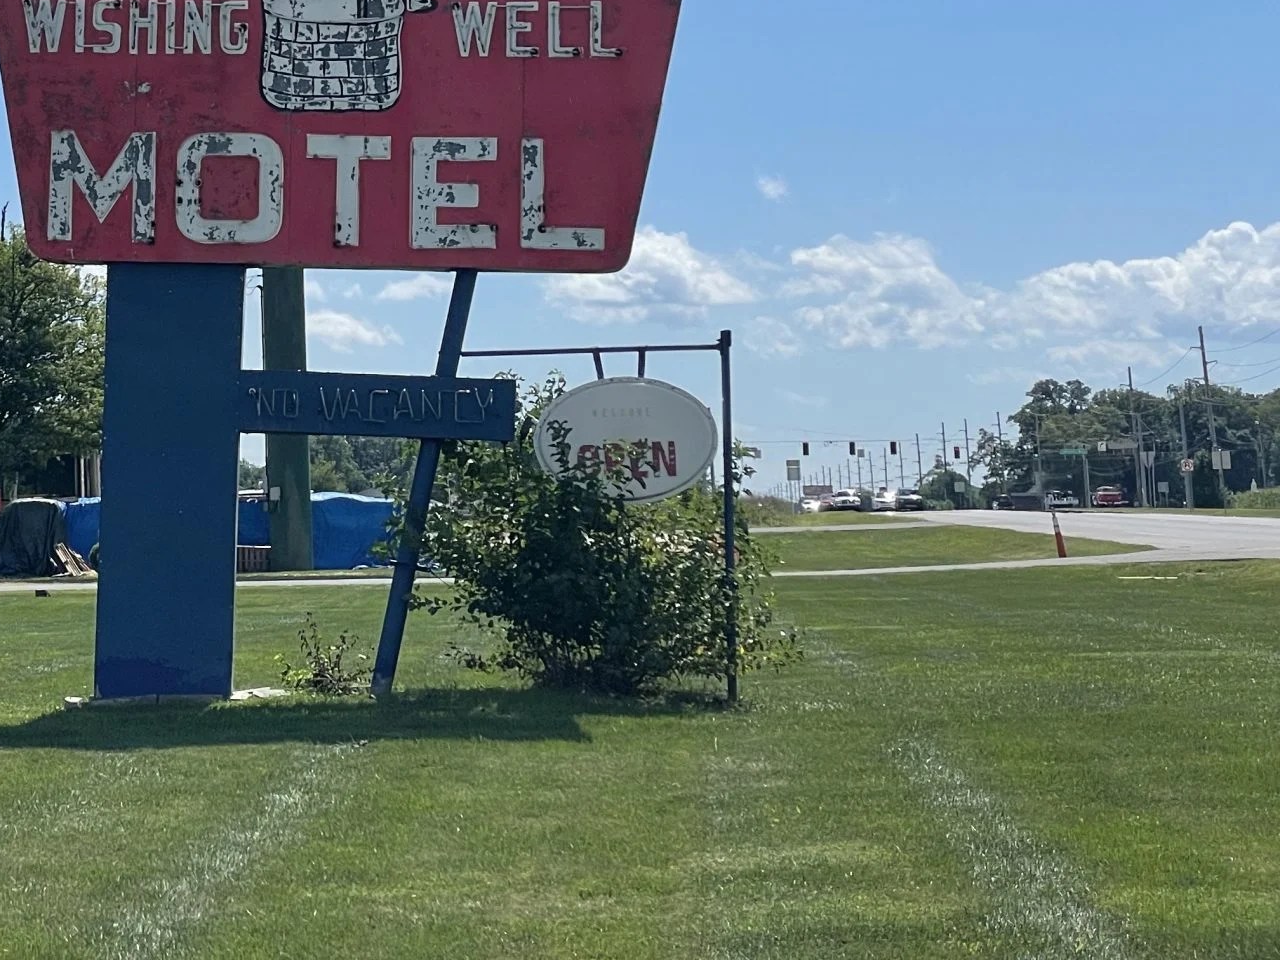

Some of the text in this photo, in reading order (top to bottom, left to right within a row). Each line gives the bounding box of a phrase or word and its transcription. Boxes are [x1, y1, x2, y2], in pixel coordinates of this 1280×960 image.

[451, 0, 623, 58] WELL
[46, 129, 605, 251] MOTEL
[256, 386, 495, 423] NO VACANCY
